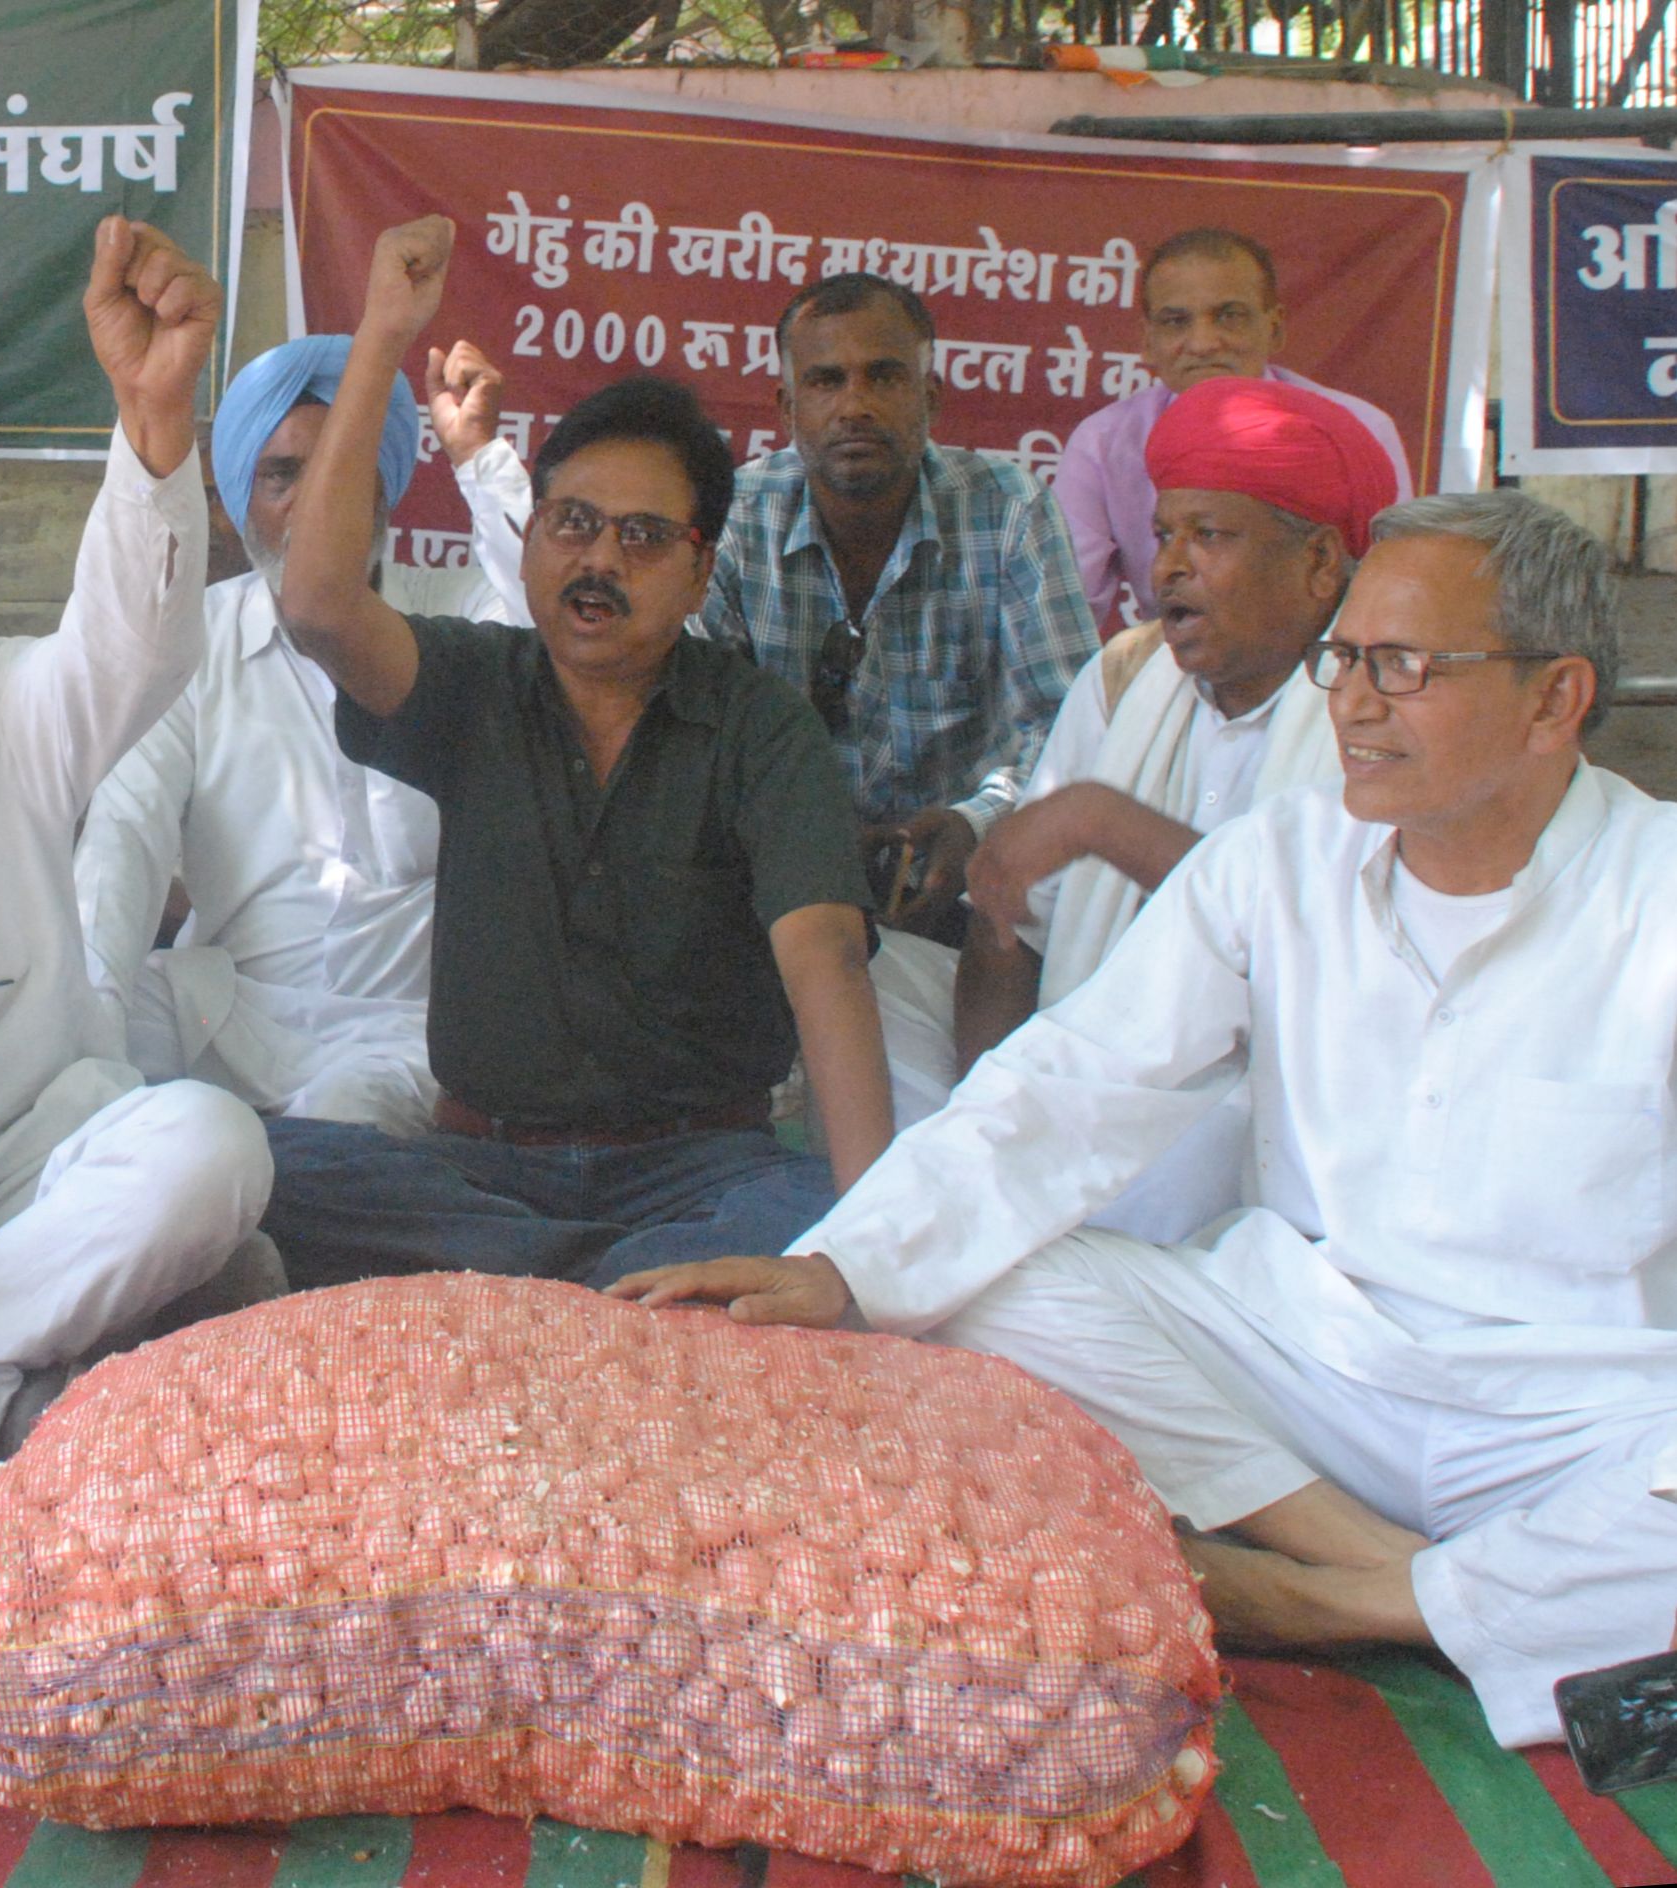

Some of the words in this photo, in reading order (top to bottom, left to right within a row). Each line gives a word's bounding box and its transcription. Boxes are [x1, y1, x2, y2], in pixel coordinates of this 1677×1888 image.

[583, 202, 659, 273] की
[668, 211, 813, 285] खरीद
[1067, 237, 1140, 308] की
[512, 304, 666, 368] 2000
[1046, 325, 1091, 398] से
